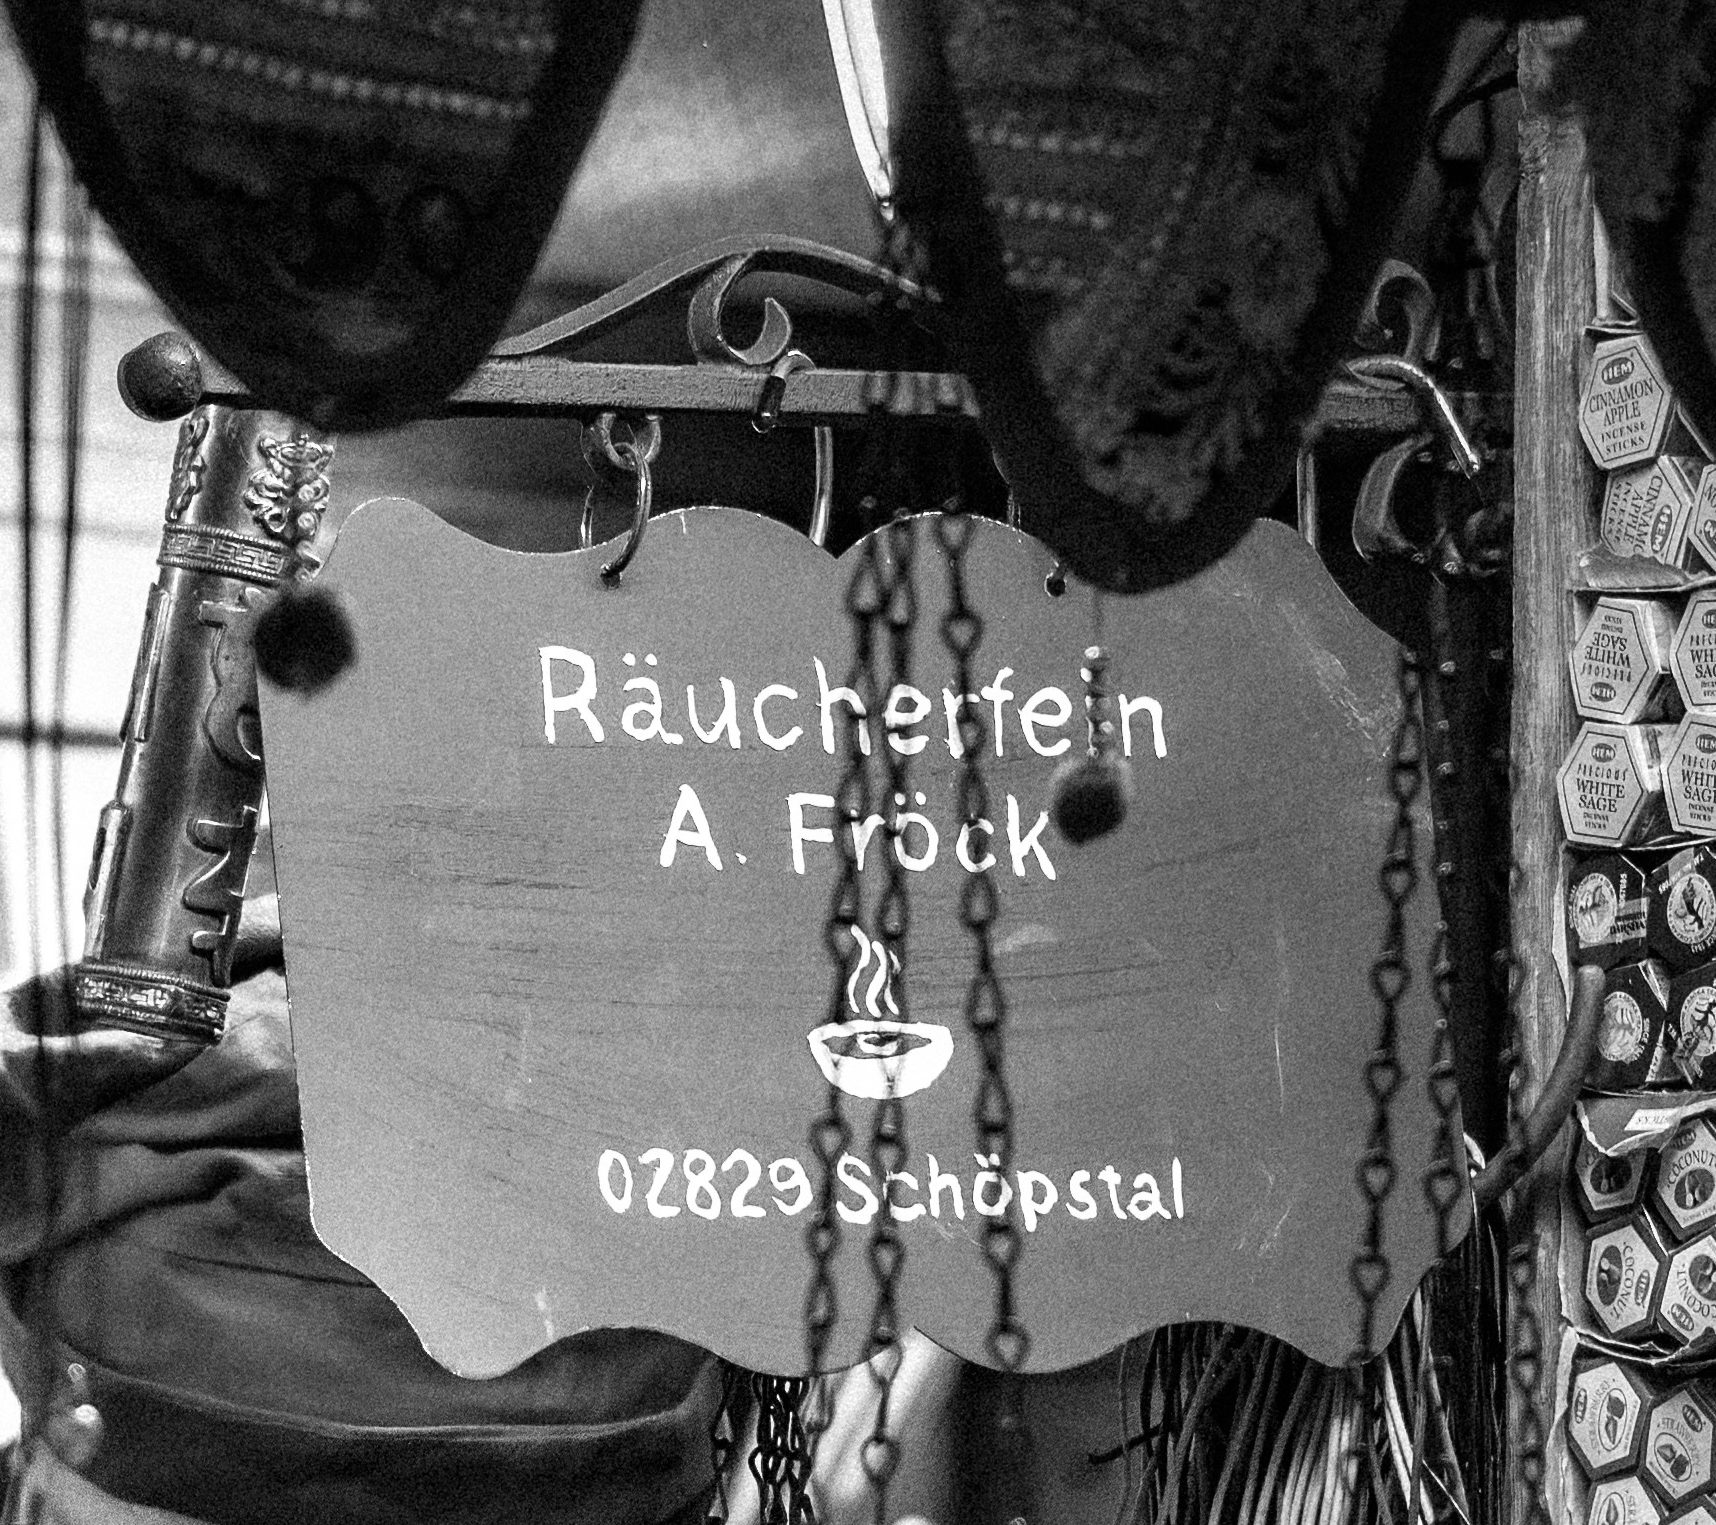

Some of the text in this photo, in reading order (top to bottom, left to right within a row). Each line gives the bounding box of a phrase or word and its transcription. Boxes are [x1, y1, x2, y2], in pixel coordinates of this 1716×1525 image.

[1602, 359, 1634, 383] HEM
[1589, 378, 1654, 413] CINNAMON
[1604, 400, 1641, 426] APPLE
[1601, 421, 1646, 442] INCENSE
[1605, 436, 1645, 455] STICKS
[1624, 489, 1644, 545] APPLE
[1633, 475, 1664, 553] CINNAMO
[1592, 631, 1627, 651] SAGE
[1584, 646, 1631, 669] WHITE
[538, 645, 1168, 758] Räucherfein
[1576, 778, 1625, 799] WHITE
[1579, 794, 1617, 812] SAGE
[658, 784, 1058, 881] A. Fröck
[596, 1147, 1185, 1232] 02829 Schöpstal
[1613, 1245, 1635, 1319] COCONUT
